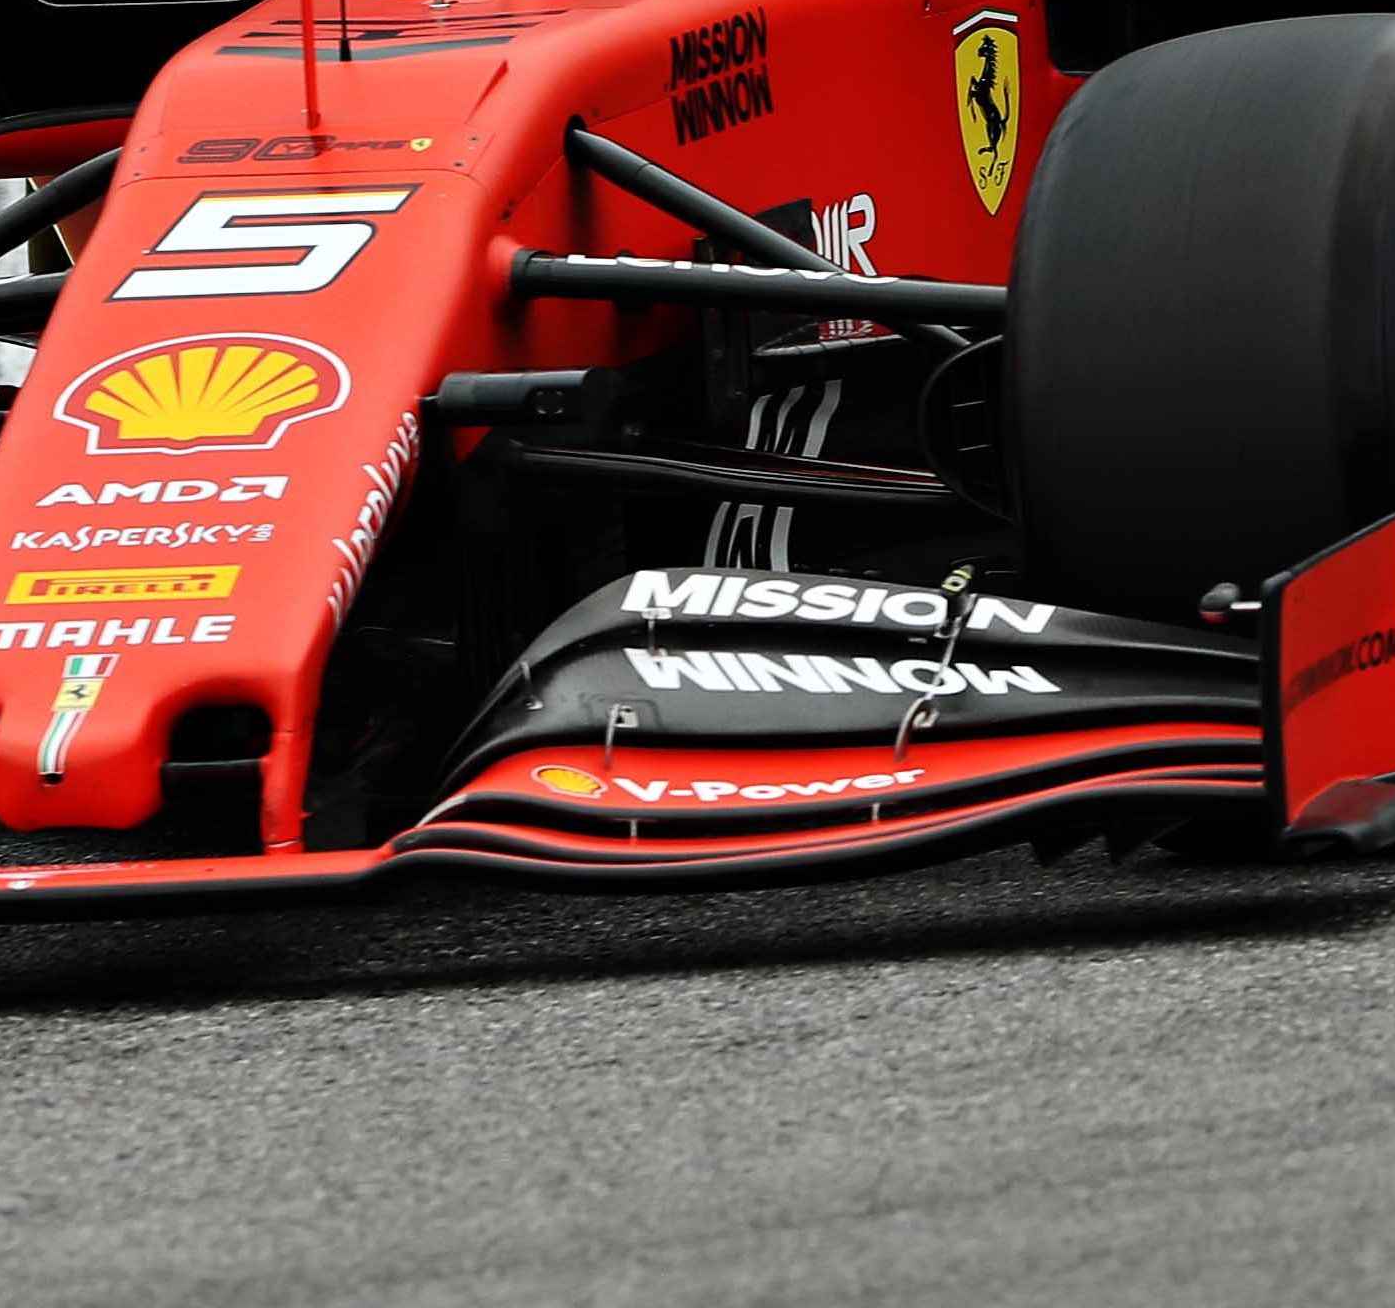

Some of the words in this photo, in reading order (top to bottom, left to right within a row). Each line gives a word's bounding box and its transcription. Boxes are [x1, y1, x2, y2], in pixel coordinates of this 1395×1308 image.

[669, 5, 767, 91] MISSION
[670, 63, 774, 147] WINNOW
[105, 182, 425, 304] 5
[35, 479, 220, 507] AMD
[10, 522, 253, 552] KASPERSKY
[29, 573, 217, 597] PIRELLI
[619, 568, 1057, 635] MISSION
[622, 647, 1062, 696] WINNOW
[613, 764, 926, 803] V-Power
